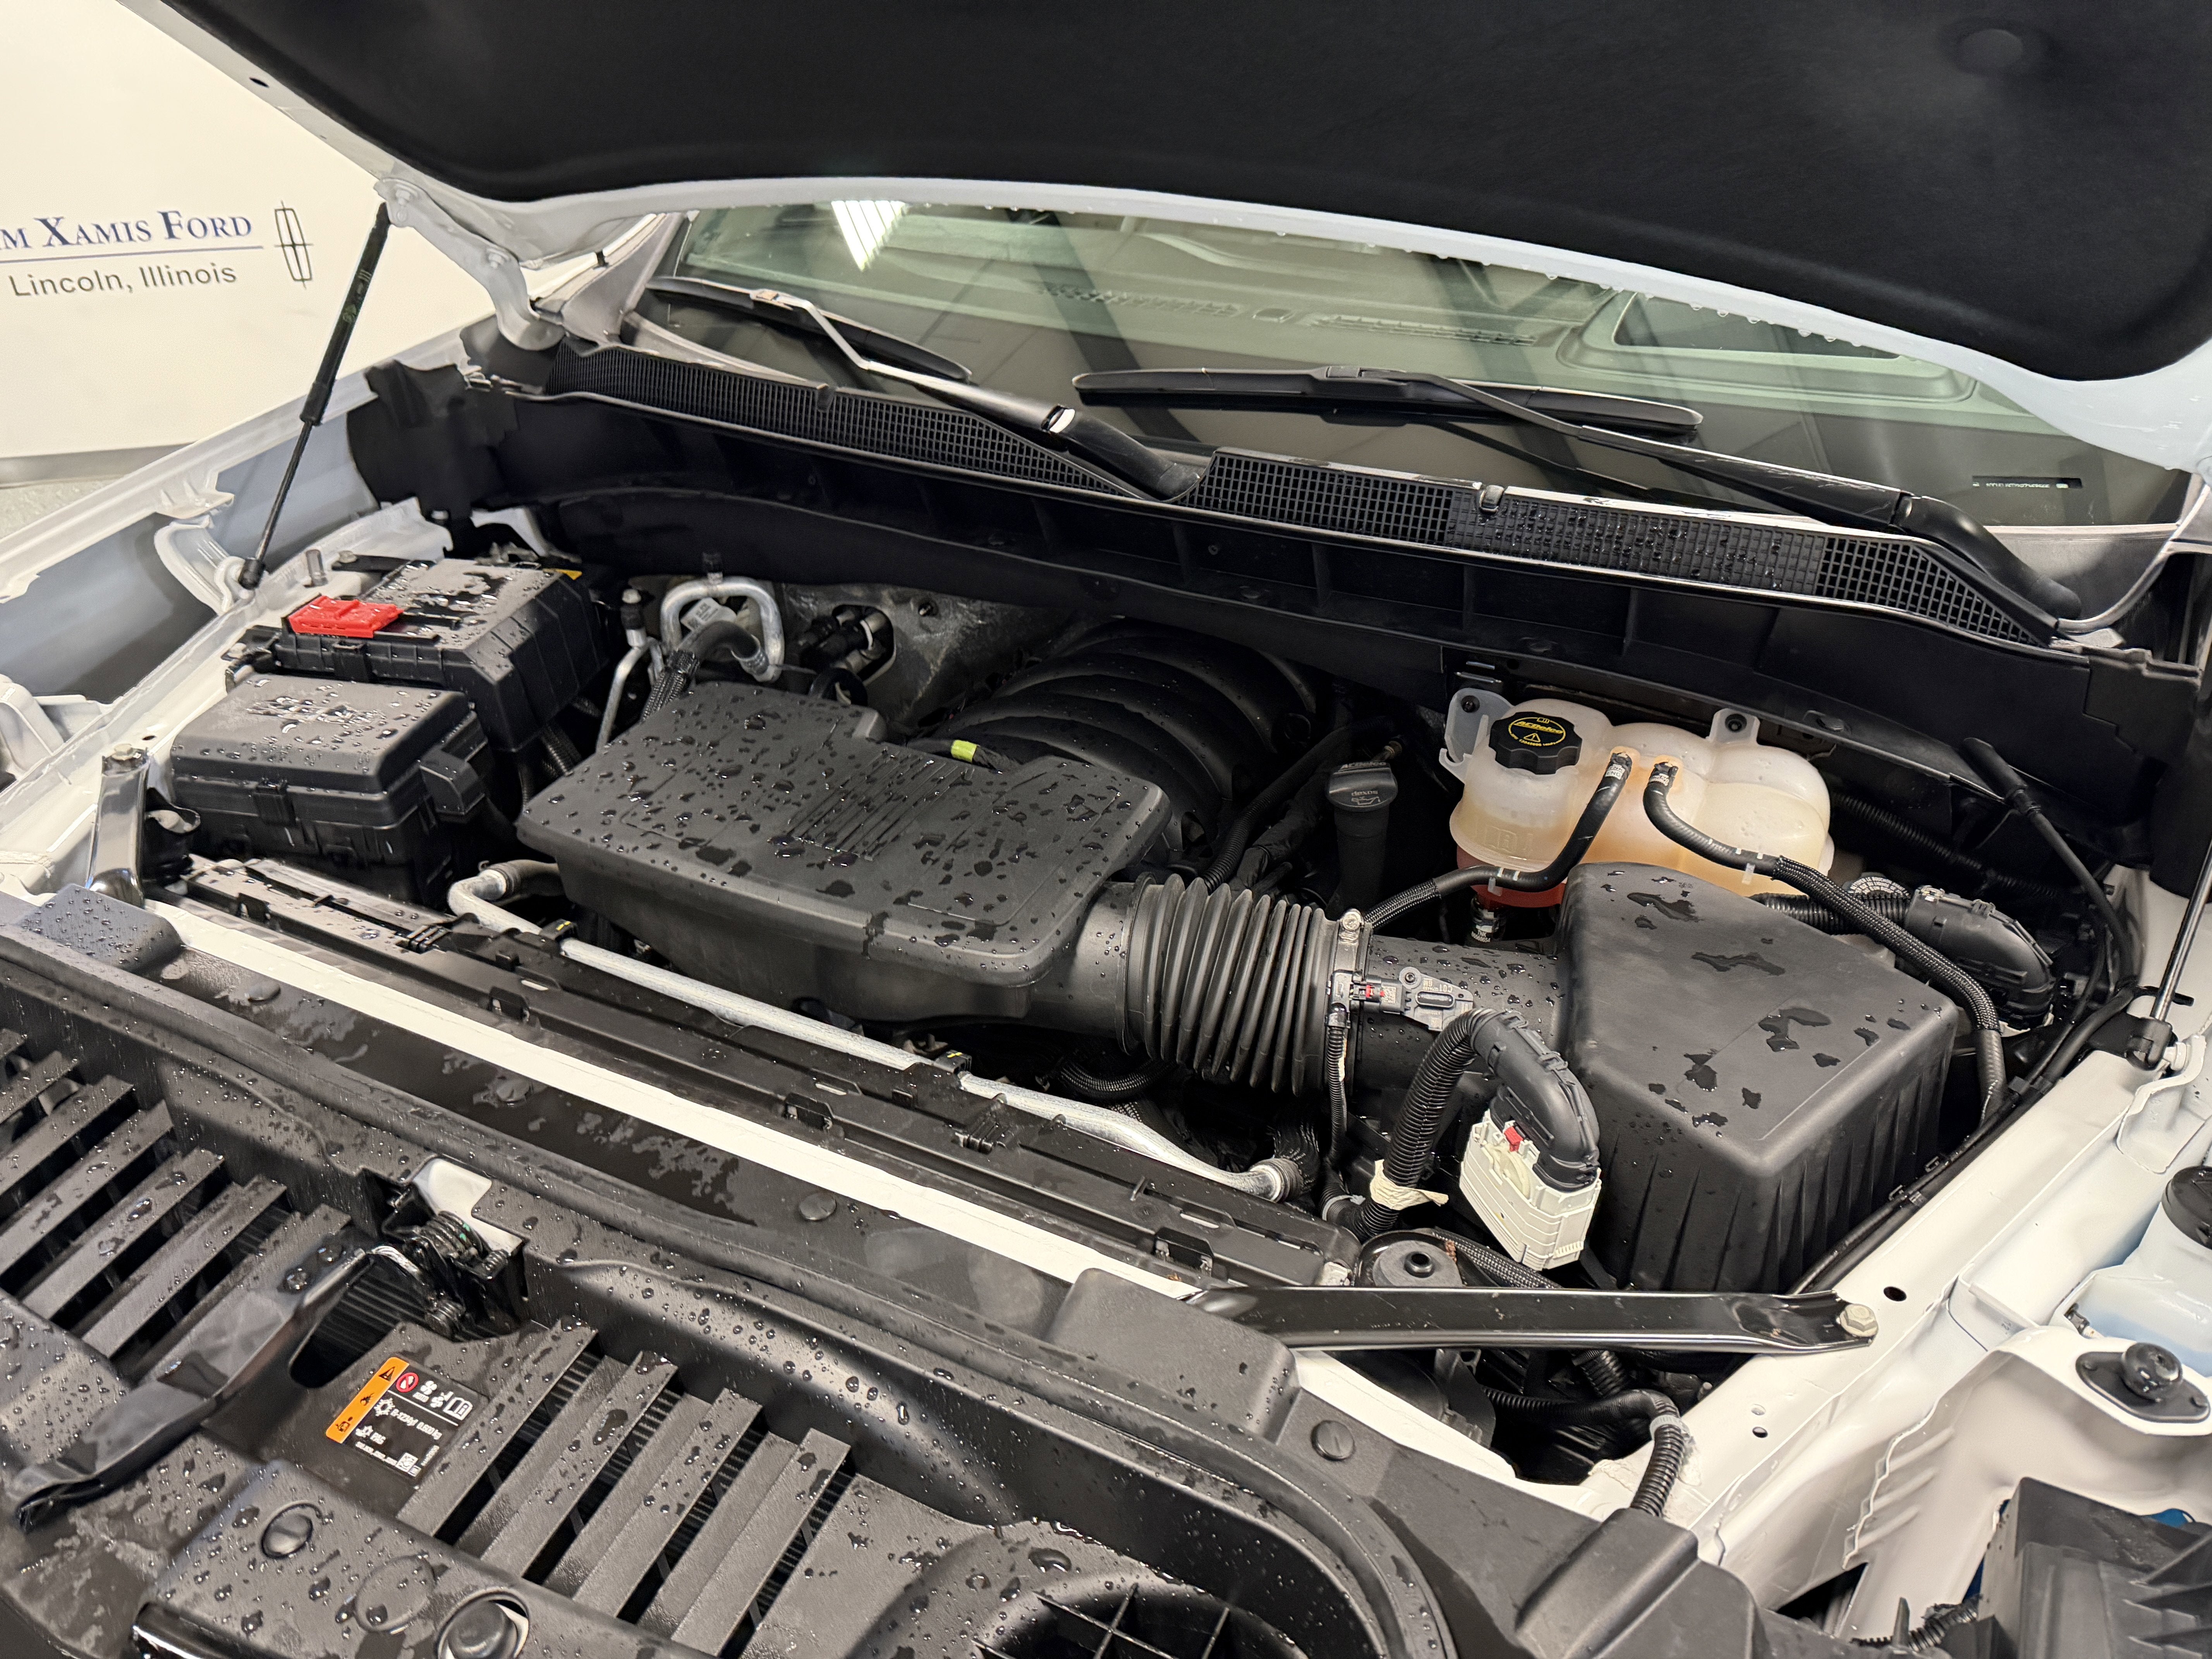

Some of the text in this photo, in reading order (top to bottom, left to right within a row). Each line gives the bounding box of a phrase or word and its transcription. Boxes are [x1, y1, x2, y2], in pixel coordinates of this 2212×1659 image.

[0, 210, 251, 250] M XAMIS FORD
[8, 262, 236, 297] Lincoln, Illinois
[1516, 721, 1563, 734] ACDelco
